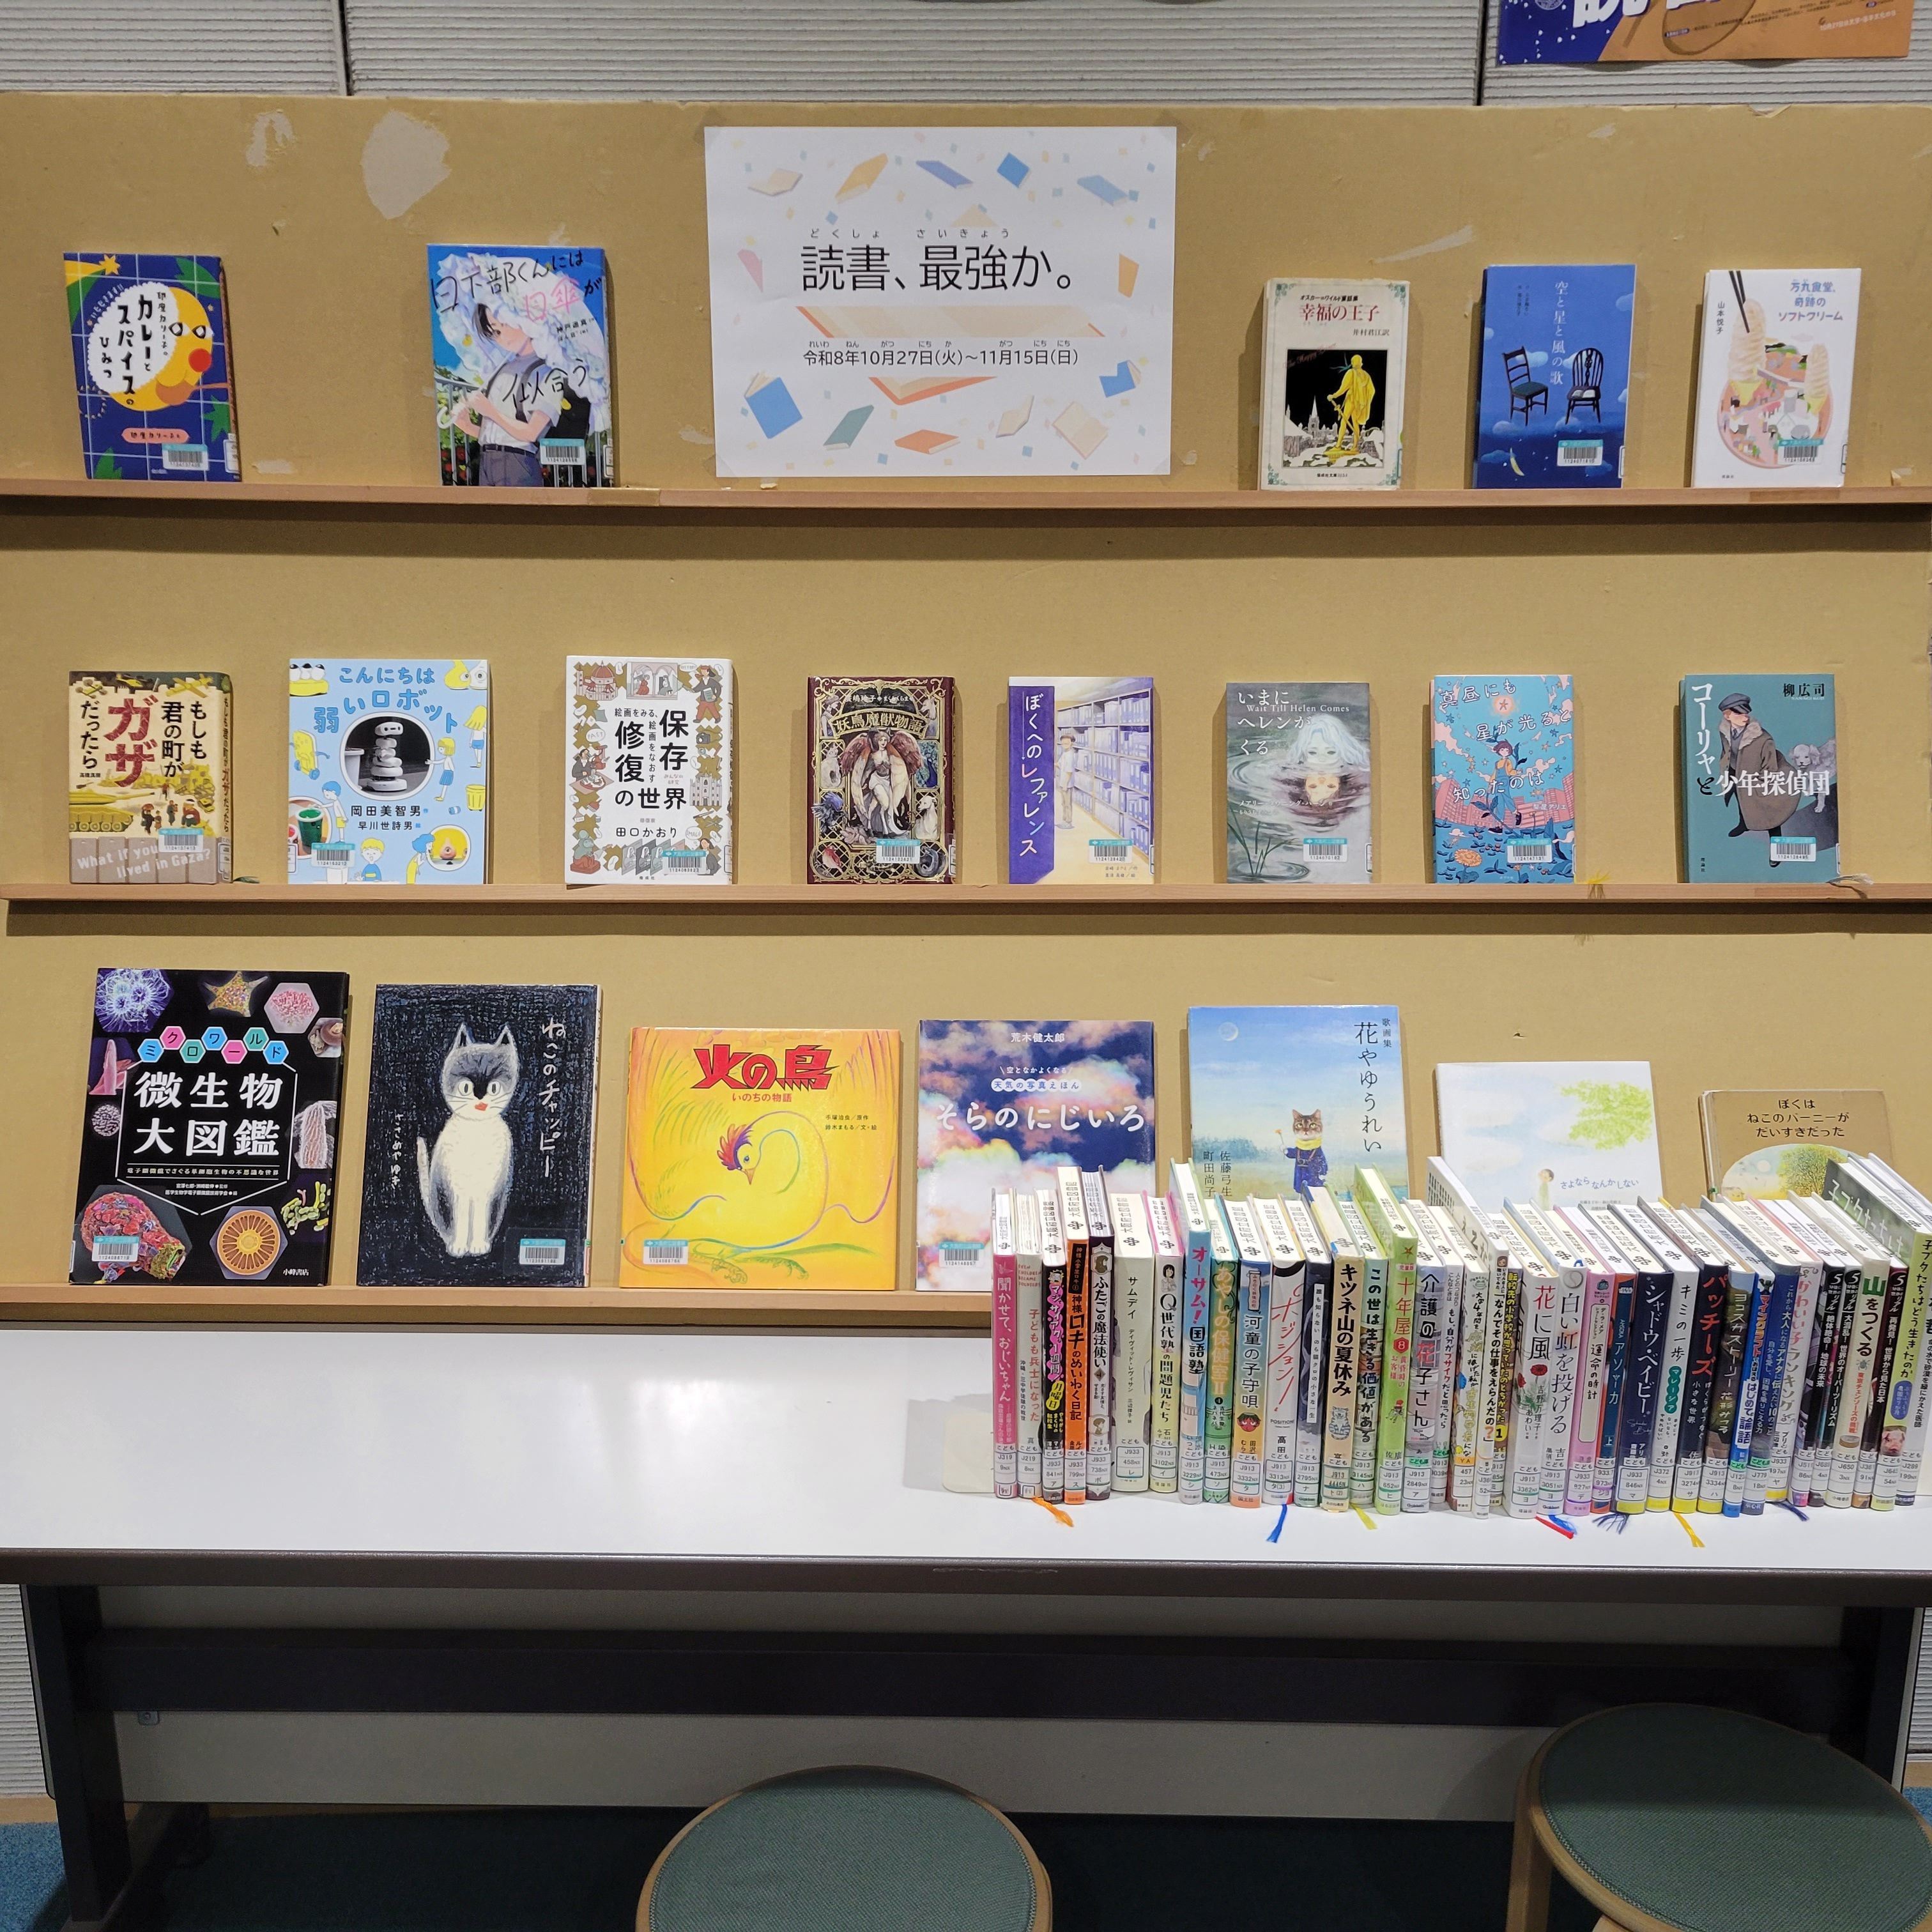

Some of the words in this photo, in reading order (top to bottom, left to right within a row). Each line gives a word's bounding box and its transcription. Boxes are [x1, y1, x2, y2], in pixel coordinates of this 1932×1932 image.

[810, 228, 880, 238] どくしょ
[916, 228, 1009, 238] さいきょう
[431, 250, 583, 313] 日下部くんには
[801, 244, 1071, 291] 読書、最強か。
[1300, 303, 1379, 321] 幸福の王子
[1717, 301, 1725, 334] 山本悦子
[1779, 310, 1843, 321] ソフトクリーム
[1795, 296, 1826, 307] 奇跡の
[117, 305, 134, 405] スパイスの
[137, 294, 153, 371] カレーと
[1551, 280, 1568, 385] 空と星と風の歌
[100, 337, 112, 378] ひみつ
[502, 359, 586, 404] 似合う
[339, 667, 435, 684] こんにちは
[1238, 689, 1289, 705] いまに
[1439, 678, 1516, 709] 真昼にも
[1782, 682, 1825, 698] 柳広司
[190, 700, 206, 760] もしも
[314, 689, 457, 733] 弱いロボット
[615, 708, 658, 718] 絵画をみる、
[1238, 716, 1312, 730] ヘレンが
[1475, 709, 1571, 742] 星が光ると
[80, 700, 100, 769] だったら
[103, 694, 158, 787] ガザ
[161, 701, 185, 778] 君の町が
[615, 721, 645, 783] 修復
[648, 721, 657, 783] 絵画をなおす
[659, 709, 689, 771] 保存
[1240, 739, 1269, 756] くる
[1019, 693, 1048, 857] ぼくへのレファレンス
[1452, 769, 1544, 804] 知ったのは
[1715, 769, 1830, 797] 少年探偵団
[351, 805, 421, 817] 岡田美智男
[615, 787, 687, 810] の世界
[358, 820, 413, 831] 早川世詩男
[616, 827, 677, 838] 田口かおり
[77, 854, 113, 870] What
[118, 848, 128, 861] if
[134, 844, 158, 859] you
[116, 863, 150, 878] lived
[155, 857, 168, 870] in
[171, 848, 211, 866] Gaza?
[144, 1031, 282, 1059] ミクロワールド
[1010, 1032, 1066, 1043] 荒木健太郎
[1381, 1018, 1392, 1048] 歌画集
[691, 1044, 839, 1091] 火の鳥
[993, 1080, 1080, 1090] 天気の写真えほん
[1006, 1066, 1067, 1075] 空となかよくなる
[1354, 1022, 1383, 1153] 花やゆうれい
[133, 1071, 284, 1110] 微生物
[539, 1016, 567, 1179] ねこのチャッピー
[732, 1092, 793, 1103] いのちの物語
[1778, 1099, 1816, 1110] ぼくは
[133, 1117, 280, 1157] 大図鑑
[937, 1102, 1145, 1132] そらのにじいろ
[1747, 1112, 1850, 1124] ねこのバーニーが
[1756, 1127, 1845, 1138] だいすきだった
[390, 1114, 404, 1189] ささめやゆき
[1219, 1151, 1233, 1197] 佐藤弓生
[1203, 1151, 1216, 1198] 町田尚子
[1560, 1176, 1639, 1190] さよならなんかしない
[1127, 1276, 1138, 1320] サムデイ
[1314, 1288, 1322, 1333] 誰も知らない
[1393, 1278, 1413, 1335] 十年屋
[1856, 1276, 1887, 1357] 山をつくる
[997, 1277, 1011, 1402] 聞かせて、おじいちゃん
[1092, 1276, 1109, 1368] ふたごの魔法使い
[1331, 1264, 1358, 1397] キツネ山の夏休み
[1528, 1284, 1556, 1361] 花に風
[1670, 1285, 1692, 1362] キミの一歩
[1691, 1276, 1728, 1377] パッチーズ
[1724, 1293, 1747, 1388] ヨコスカストーリー
[1752, 1294, 1771, 1357] マインクラフト
[1029, 1308, 1039, 1422] 子どもも兵士になった
[1068, 1294, 1084, 1422] 神様ロキのめいわく日記
[1158, 1292, 1177, 1423] Q世代塾の問題児たち
[1241, 1315, 1264, 1409] 河童の子守唄
[1360, 1269, 1381, 1444] この世は生きる価値がある
[1413, 1273, 1439, 1428] 介護の花子さん
[1549, 1292, 1580, 1435] 白い虹を投げる
[1780, 1280, 1811, 1412] かわいい子ランキング
[1587, 1343, 1604, 1400] 運命の時計
[1666, 1368, 1681, 1411] マレーシア
[1048, 1382, 1063, 1409] 月曜日
[1533, 1385, 1545, 1432] 吉野万理子
[1687, 1381, 1701, 1424] 小さな世界
[1736, 1382, 1757, 1445] はじめて論語
